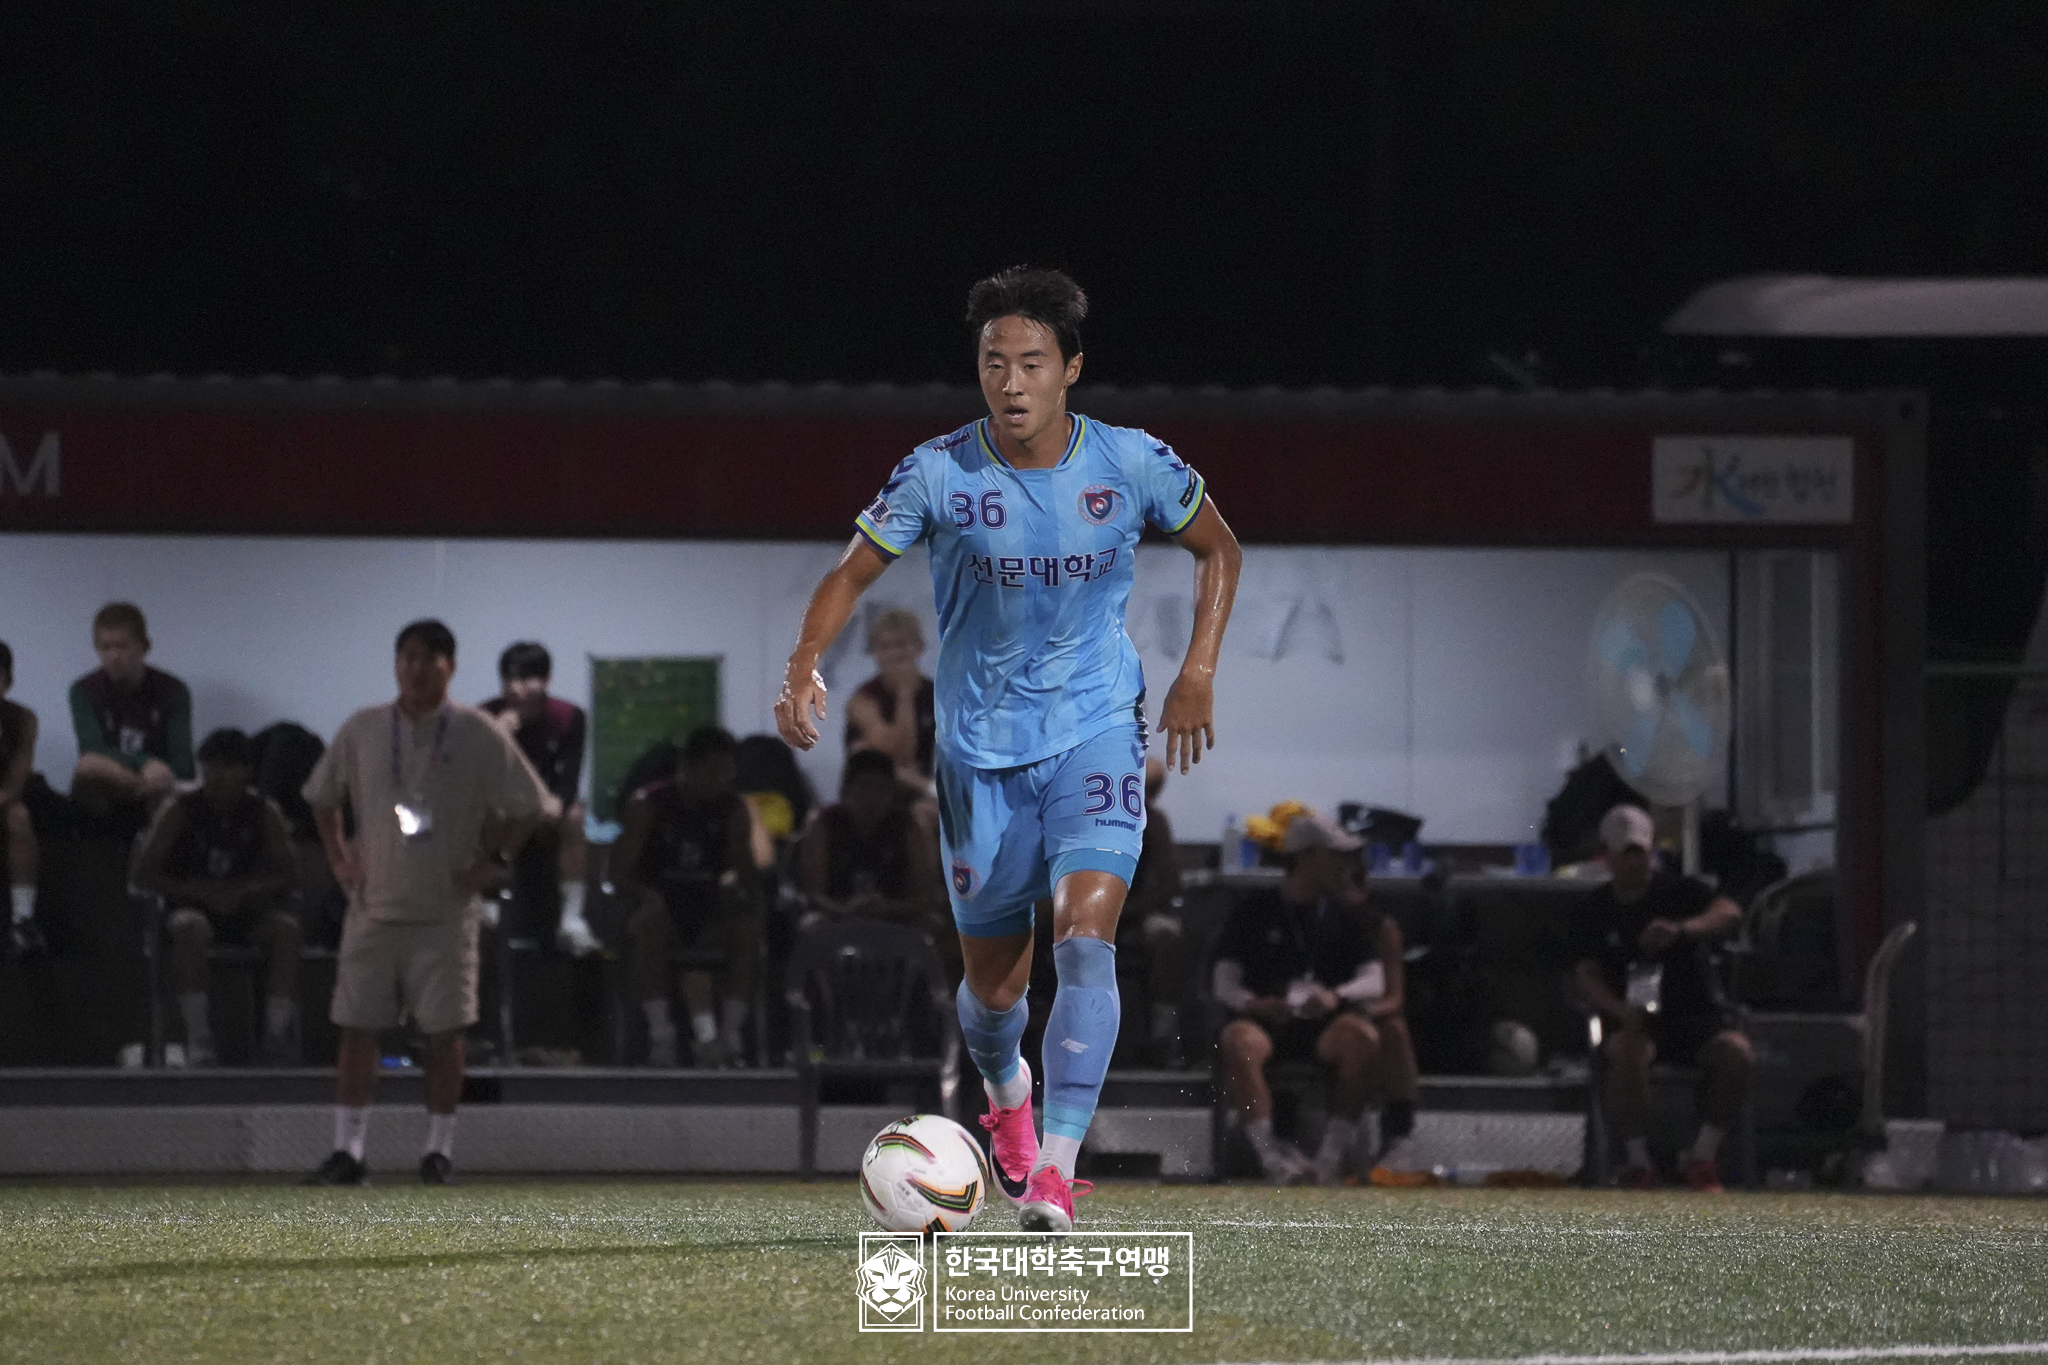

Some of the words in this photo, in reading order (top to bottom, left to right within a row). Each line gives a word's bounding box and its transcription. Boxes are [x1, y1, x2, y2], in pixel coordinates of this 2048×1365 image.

[950, 490, 1007, 529] 36
[968, 547, 1118, 588] 선문대학교
[1082, 772, 1142, 820] 36
[1095, 818, 1137, 832] hummel
